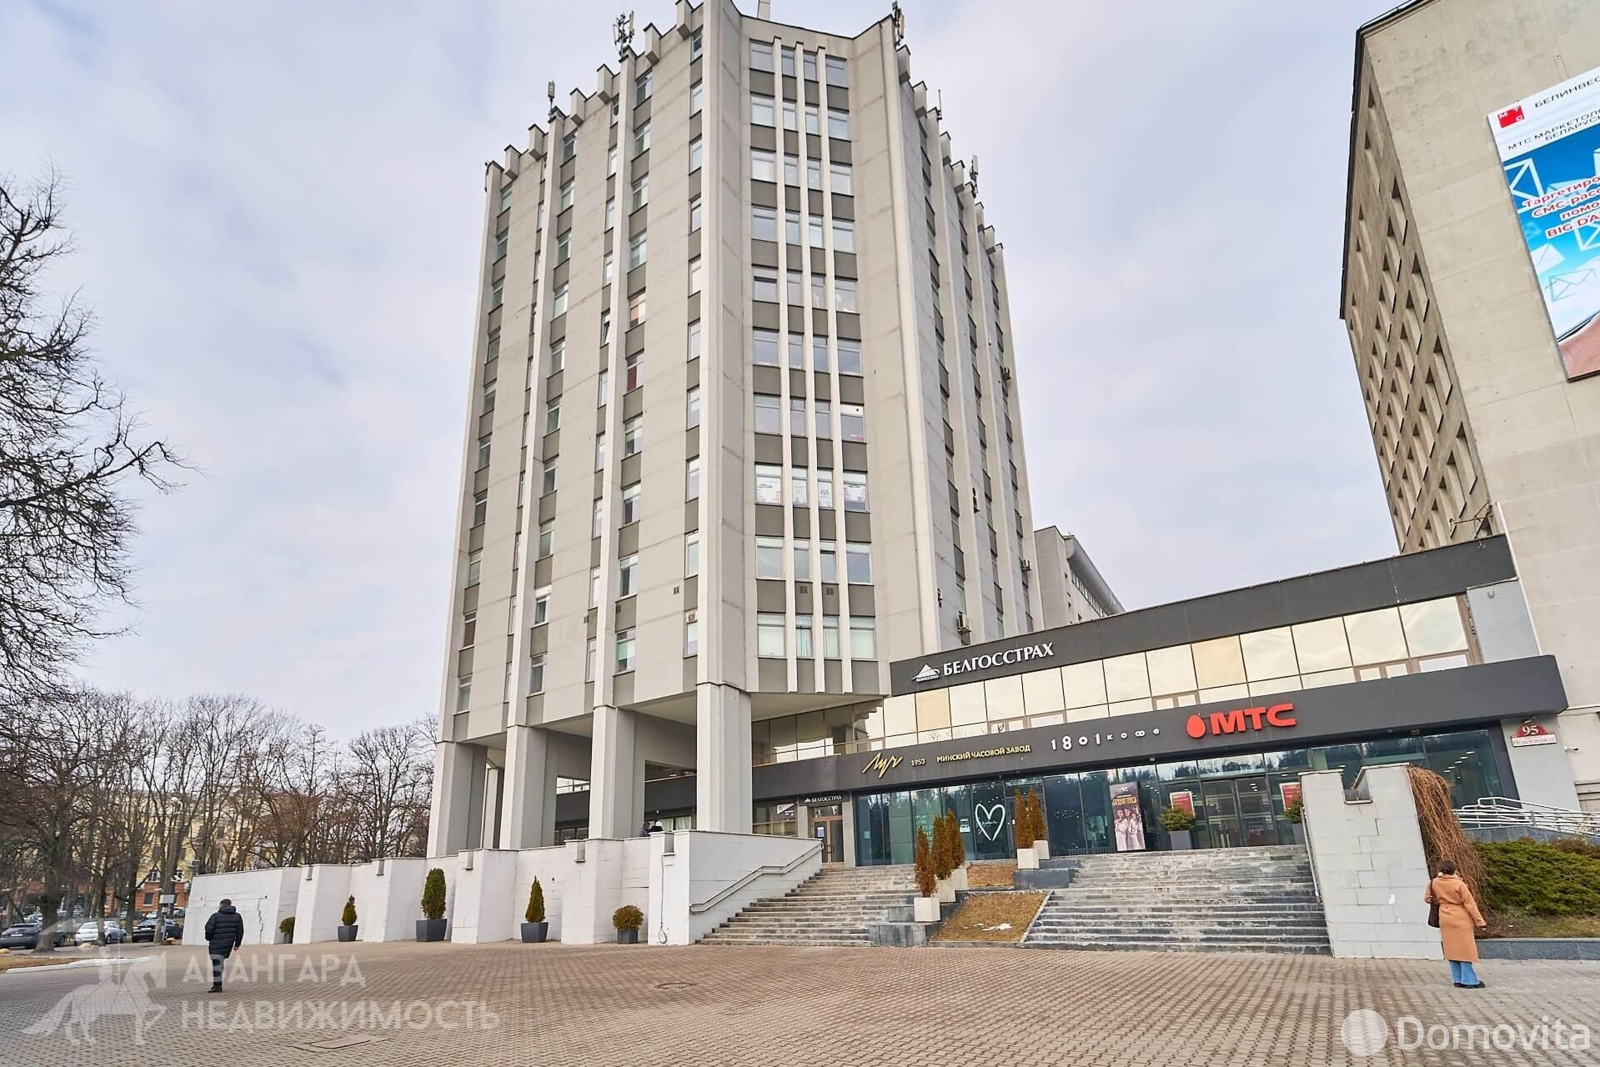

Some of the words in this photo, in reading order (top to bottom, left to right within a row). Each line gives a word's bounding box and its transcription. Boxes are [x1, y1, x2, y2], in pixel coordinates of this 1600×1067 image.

[1534, 108, 1600, 140] МАРКЕТОЛ
[1547, 223, 1573, 237] BIG
[943, 642, 1054, 676] БЕЛГОССТРАХ
[1209, 702, 1297, 735] МТС
[1522, 725, 1539, 736] 95
[911, 758, 926, 767] 1953
[936, 752, 971, 763] МИНСКИЙ
[971, 748, 1005, 759] ЧАСОВОЙ
[1006, 744, 1031, 755] ЗАВОД
